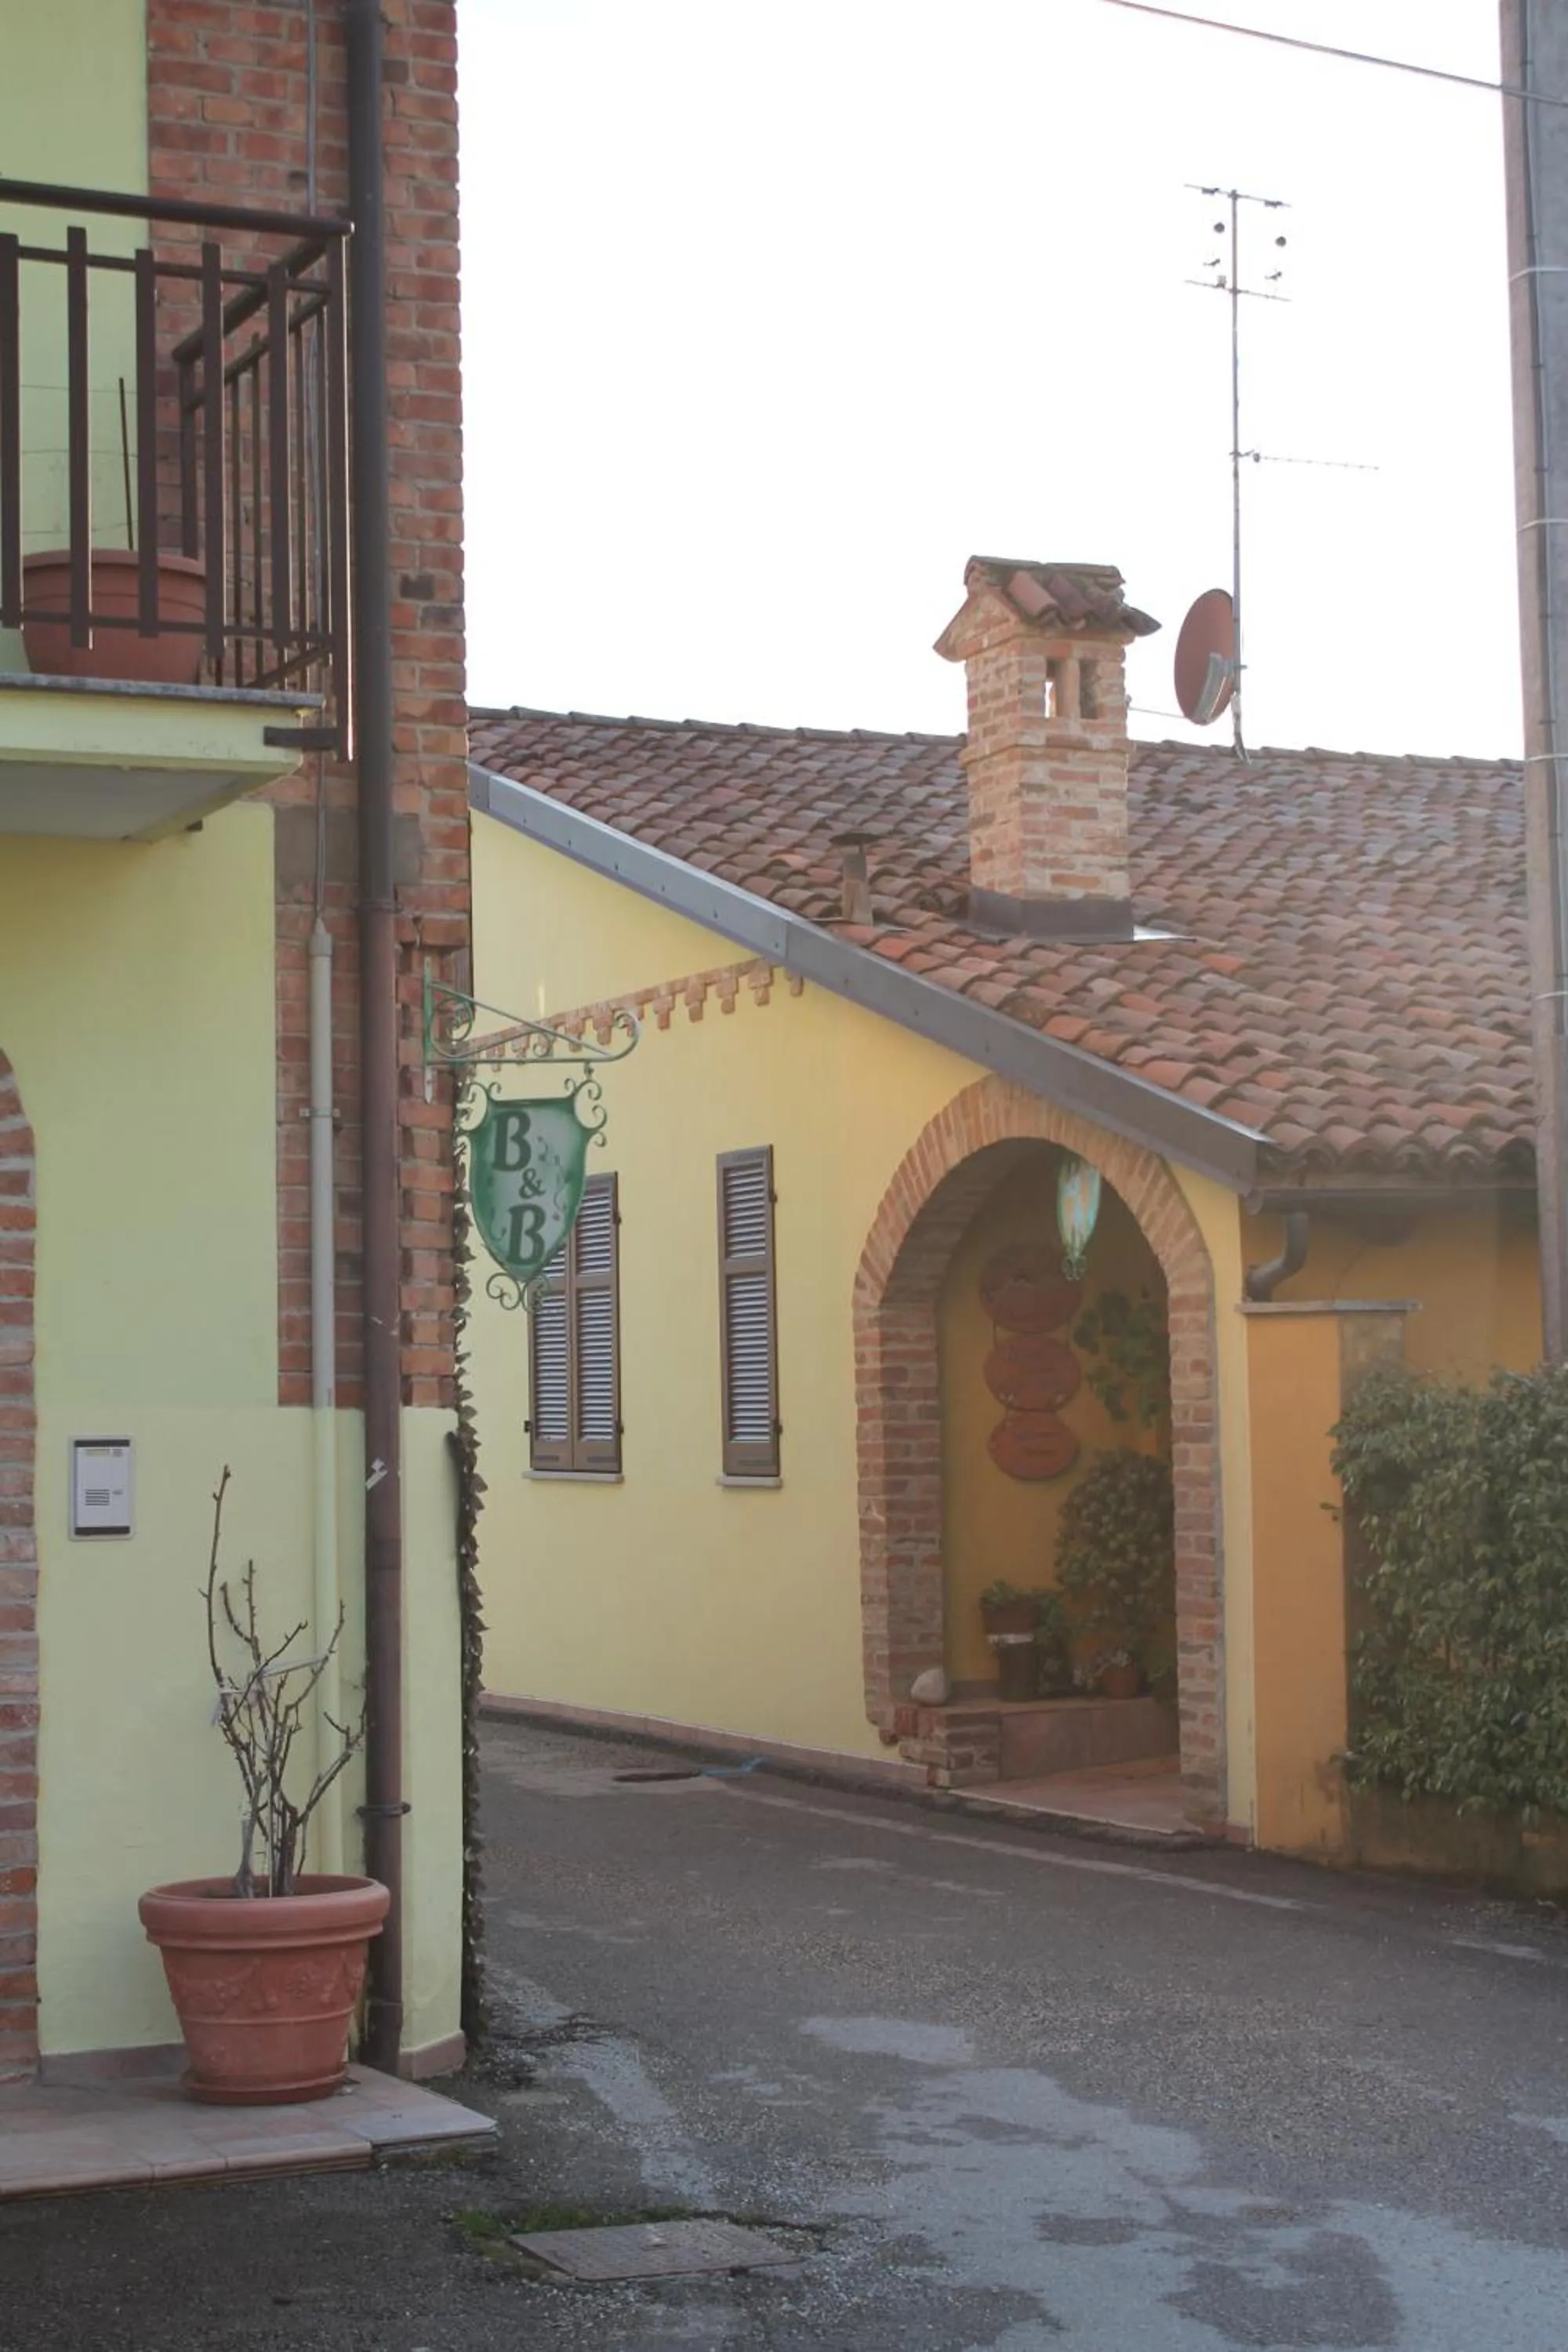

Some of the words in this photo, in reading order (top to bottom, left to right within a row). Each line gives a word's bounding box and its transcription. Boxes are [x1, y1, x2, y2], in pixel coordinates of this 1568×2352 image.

[492, 1111, 531, 1171] B
[519, 1169, 546, 1199] &
[506, 1204, 546, 1265] B
